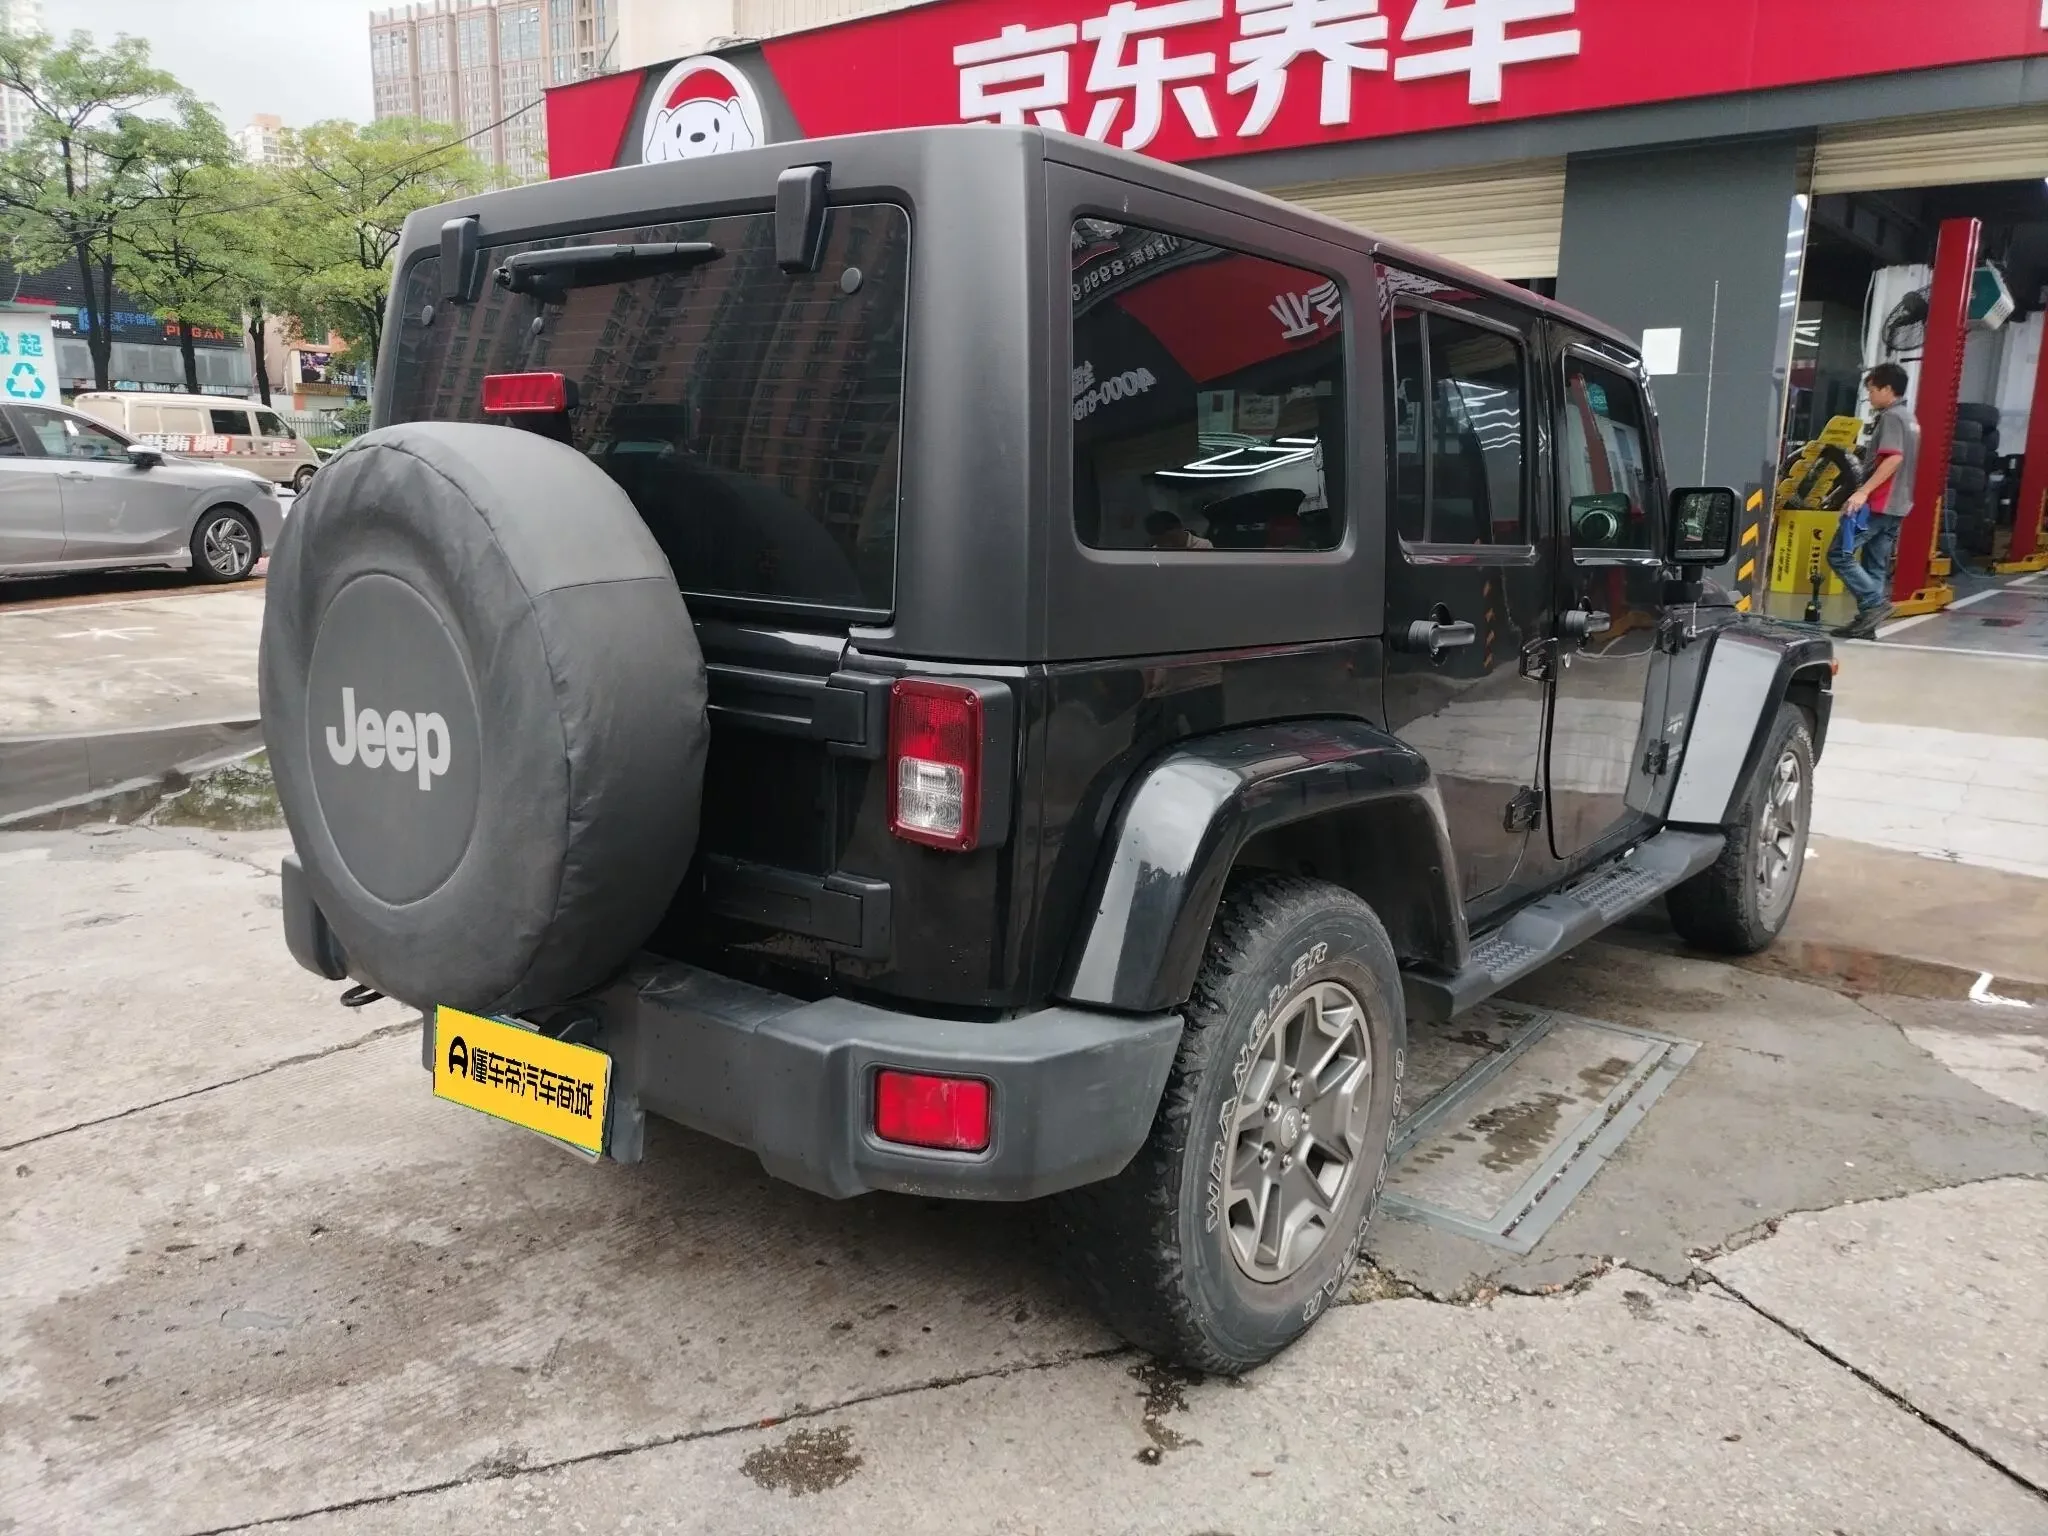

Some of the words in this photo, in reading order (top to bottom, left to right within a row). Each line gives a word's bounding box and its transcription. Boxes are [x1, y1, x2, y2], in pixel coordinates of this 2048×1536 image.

[953, 0, 1581, 149] 京东养车
[166, 325, 225, 340] PIGAN
[325, 687, 451, 792] Jeep
[1206, 941, 1329, 1234] WRANGLER
